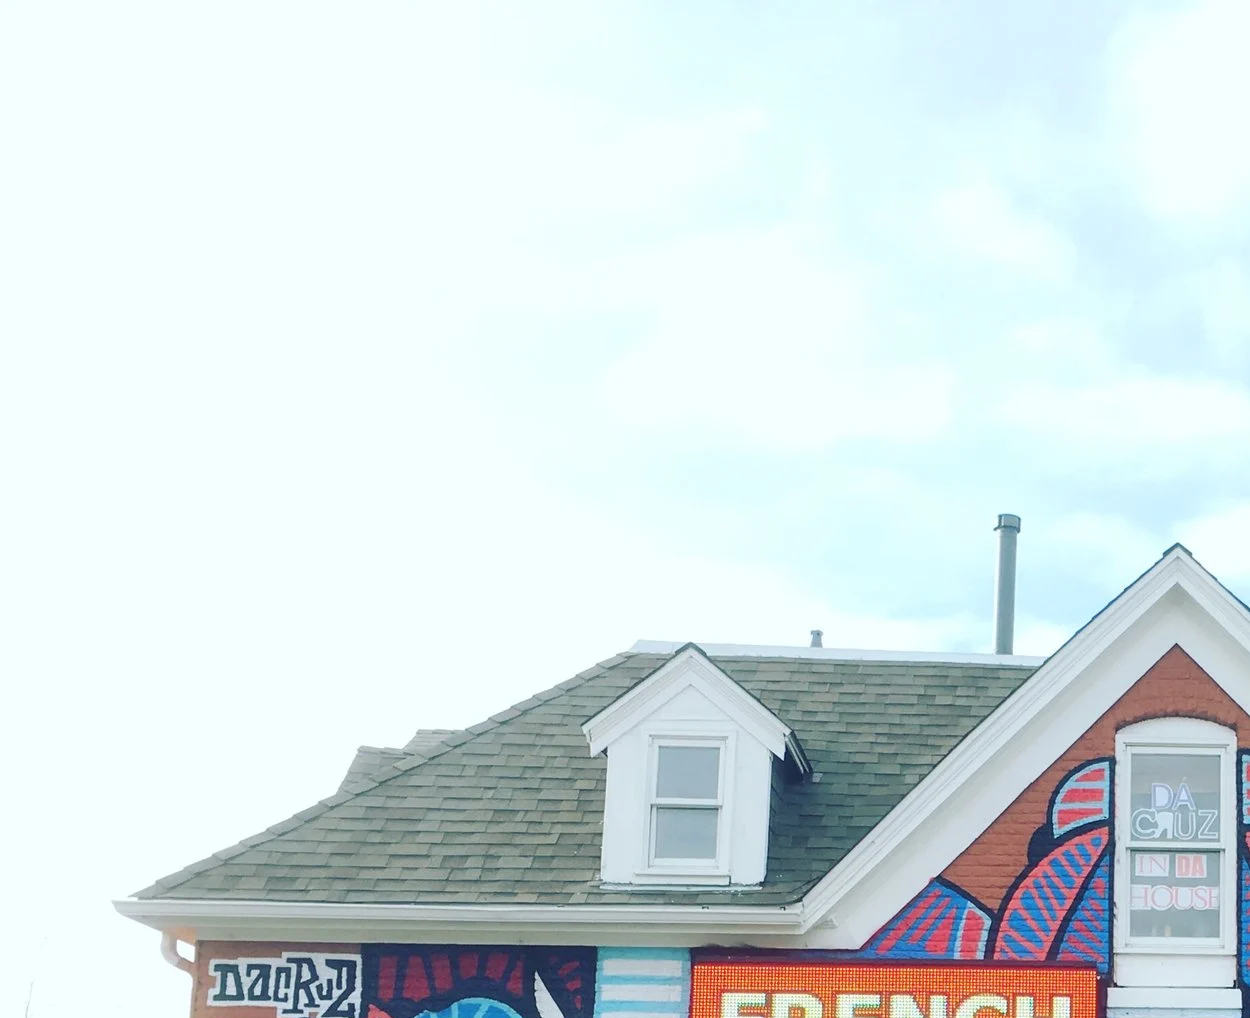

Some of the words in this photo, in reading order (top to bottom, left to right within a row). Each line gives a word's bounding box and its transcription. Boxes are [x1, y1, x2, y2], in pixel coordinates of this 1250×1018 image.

[1151, 782, 1196, 811] DA
[1137, 855, 1169, 874] IN
[1176, 855, 1206, 877] DA
